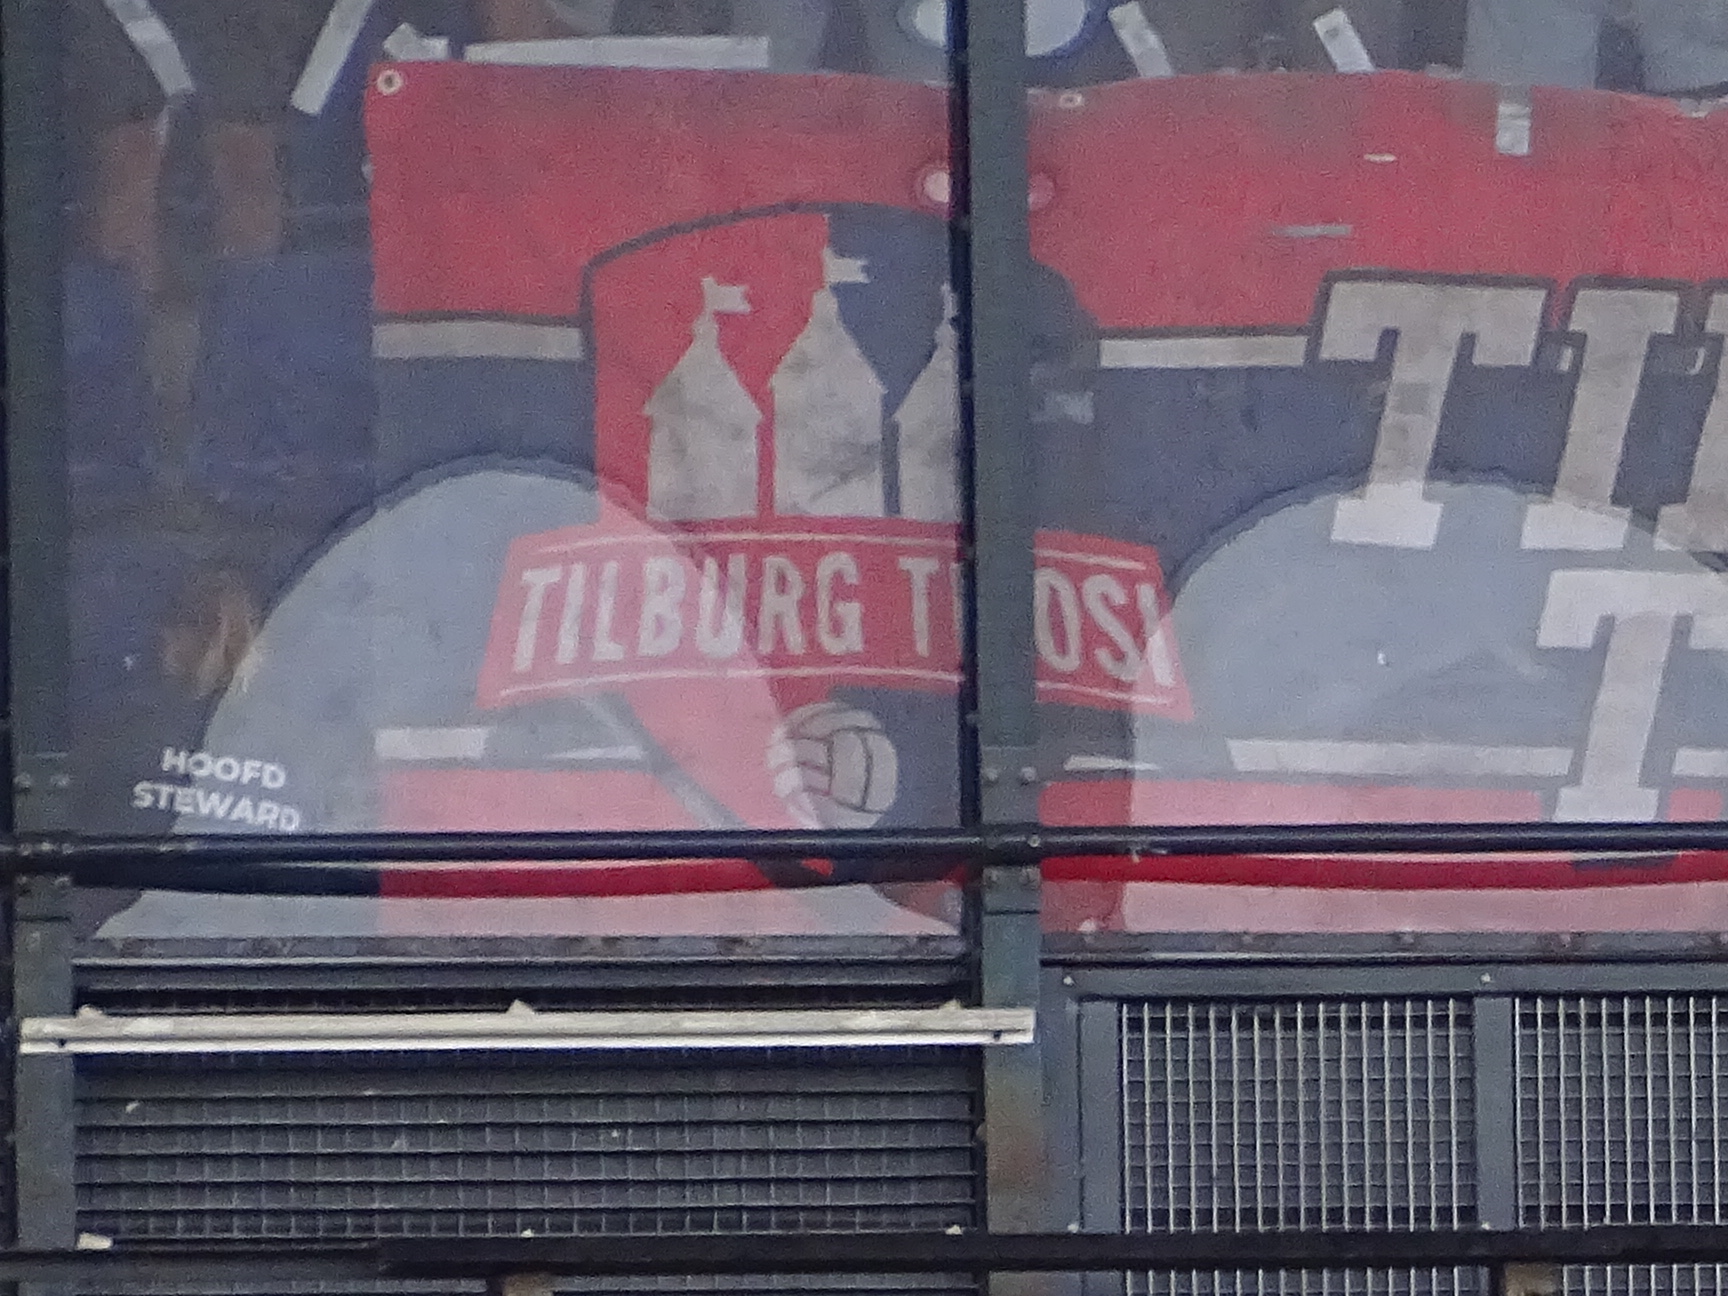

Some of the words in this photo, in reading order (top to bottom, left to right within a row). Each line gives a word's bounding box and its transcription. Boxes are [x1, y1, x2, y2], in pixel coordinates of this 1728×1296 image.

[513, 551, 864, 672] TILBURG
[899, 555, 1177, 687] TOSI
[161, 747, 285, 789] HOOFD
[132, 781, 300, 831] STEWARD
